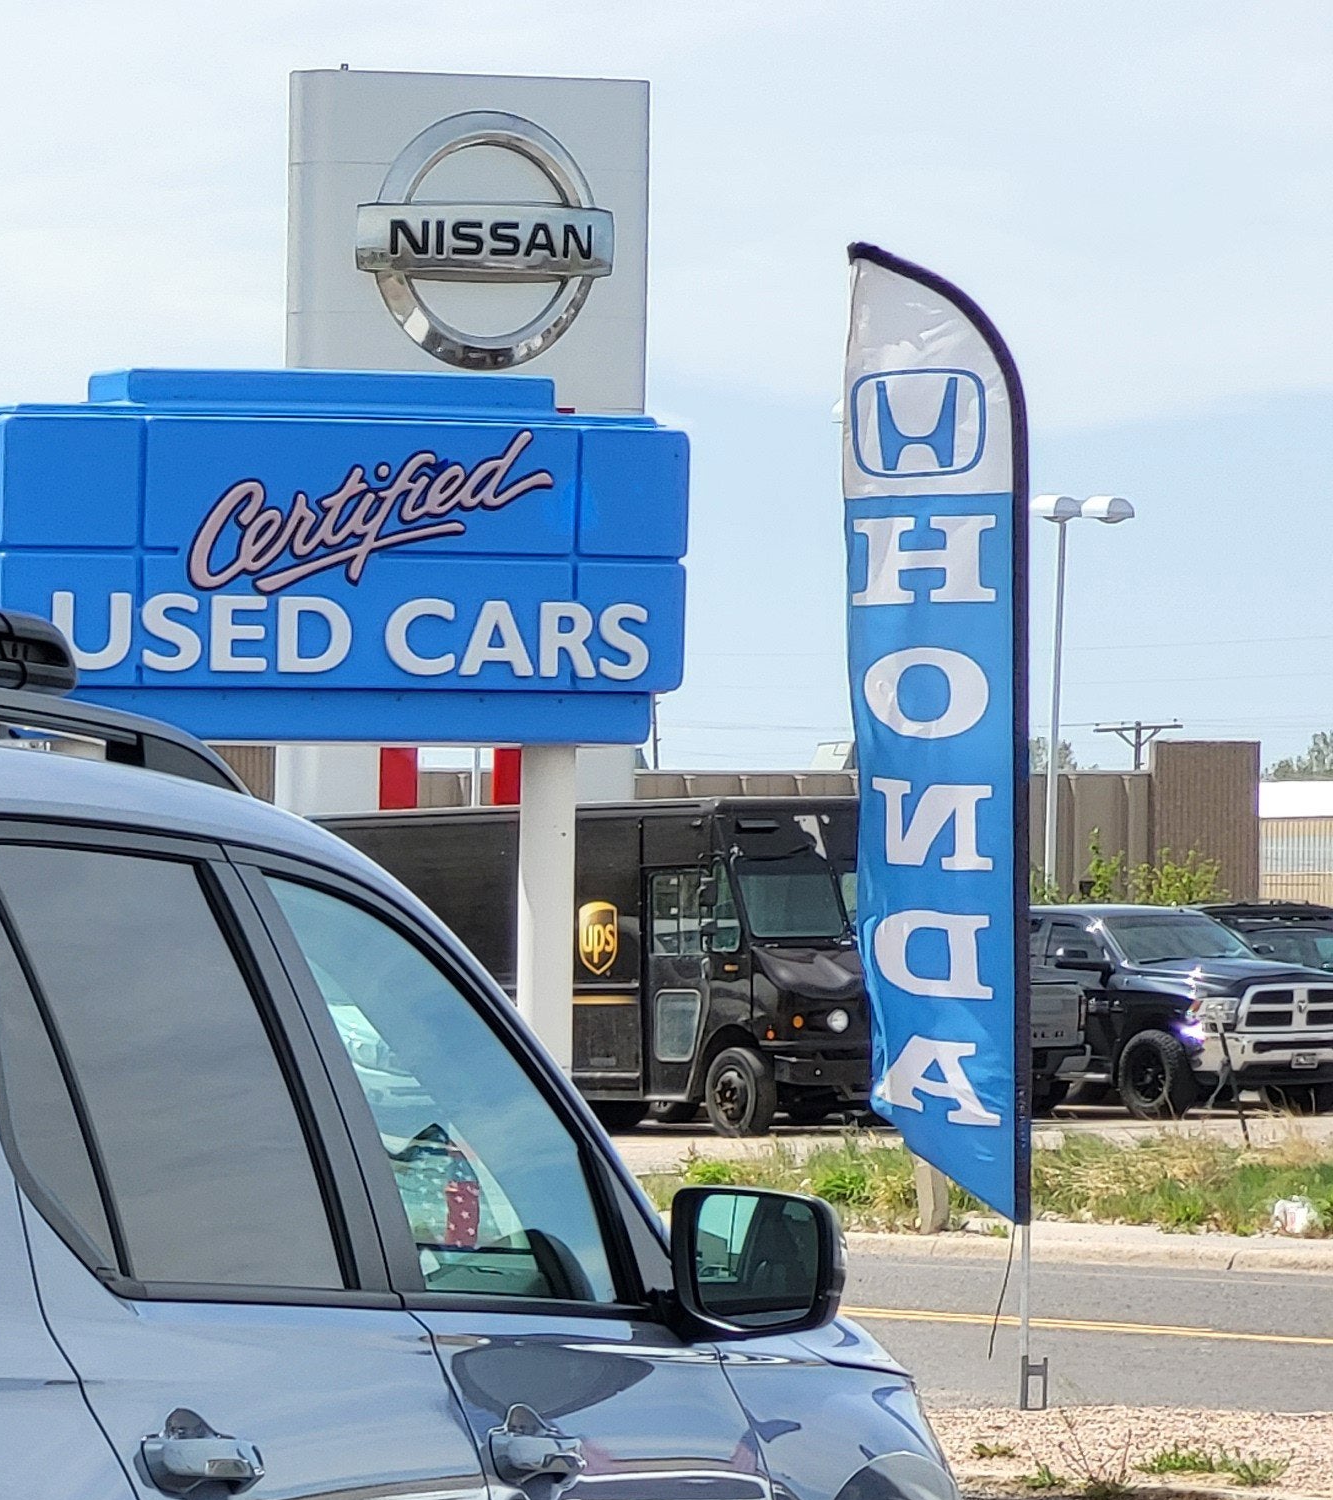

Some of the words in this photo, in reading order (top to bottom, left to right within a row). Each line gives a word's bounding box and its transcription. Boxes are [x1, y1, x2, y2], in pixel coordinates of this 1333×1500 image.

[389, 219, 594, 261] NISSAN
[187, 430, 553, 592] Certified
[49, 591, 353, 674] USED
[384, 598, 650, 680] CARS
[583, 924, 615, 963] ups
